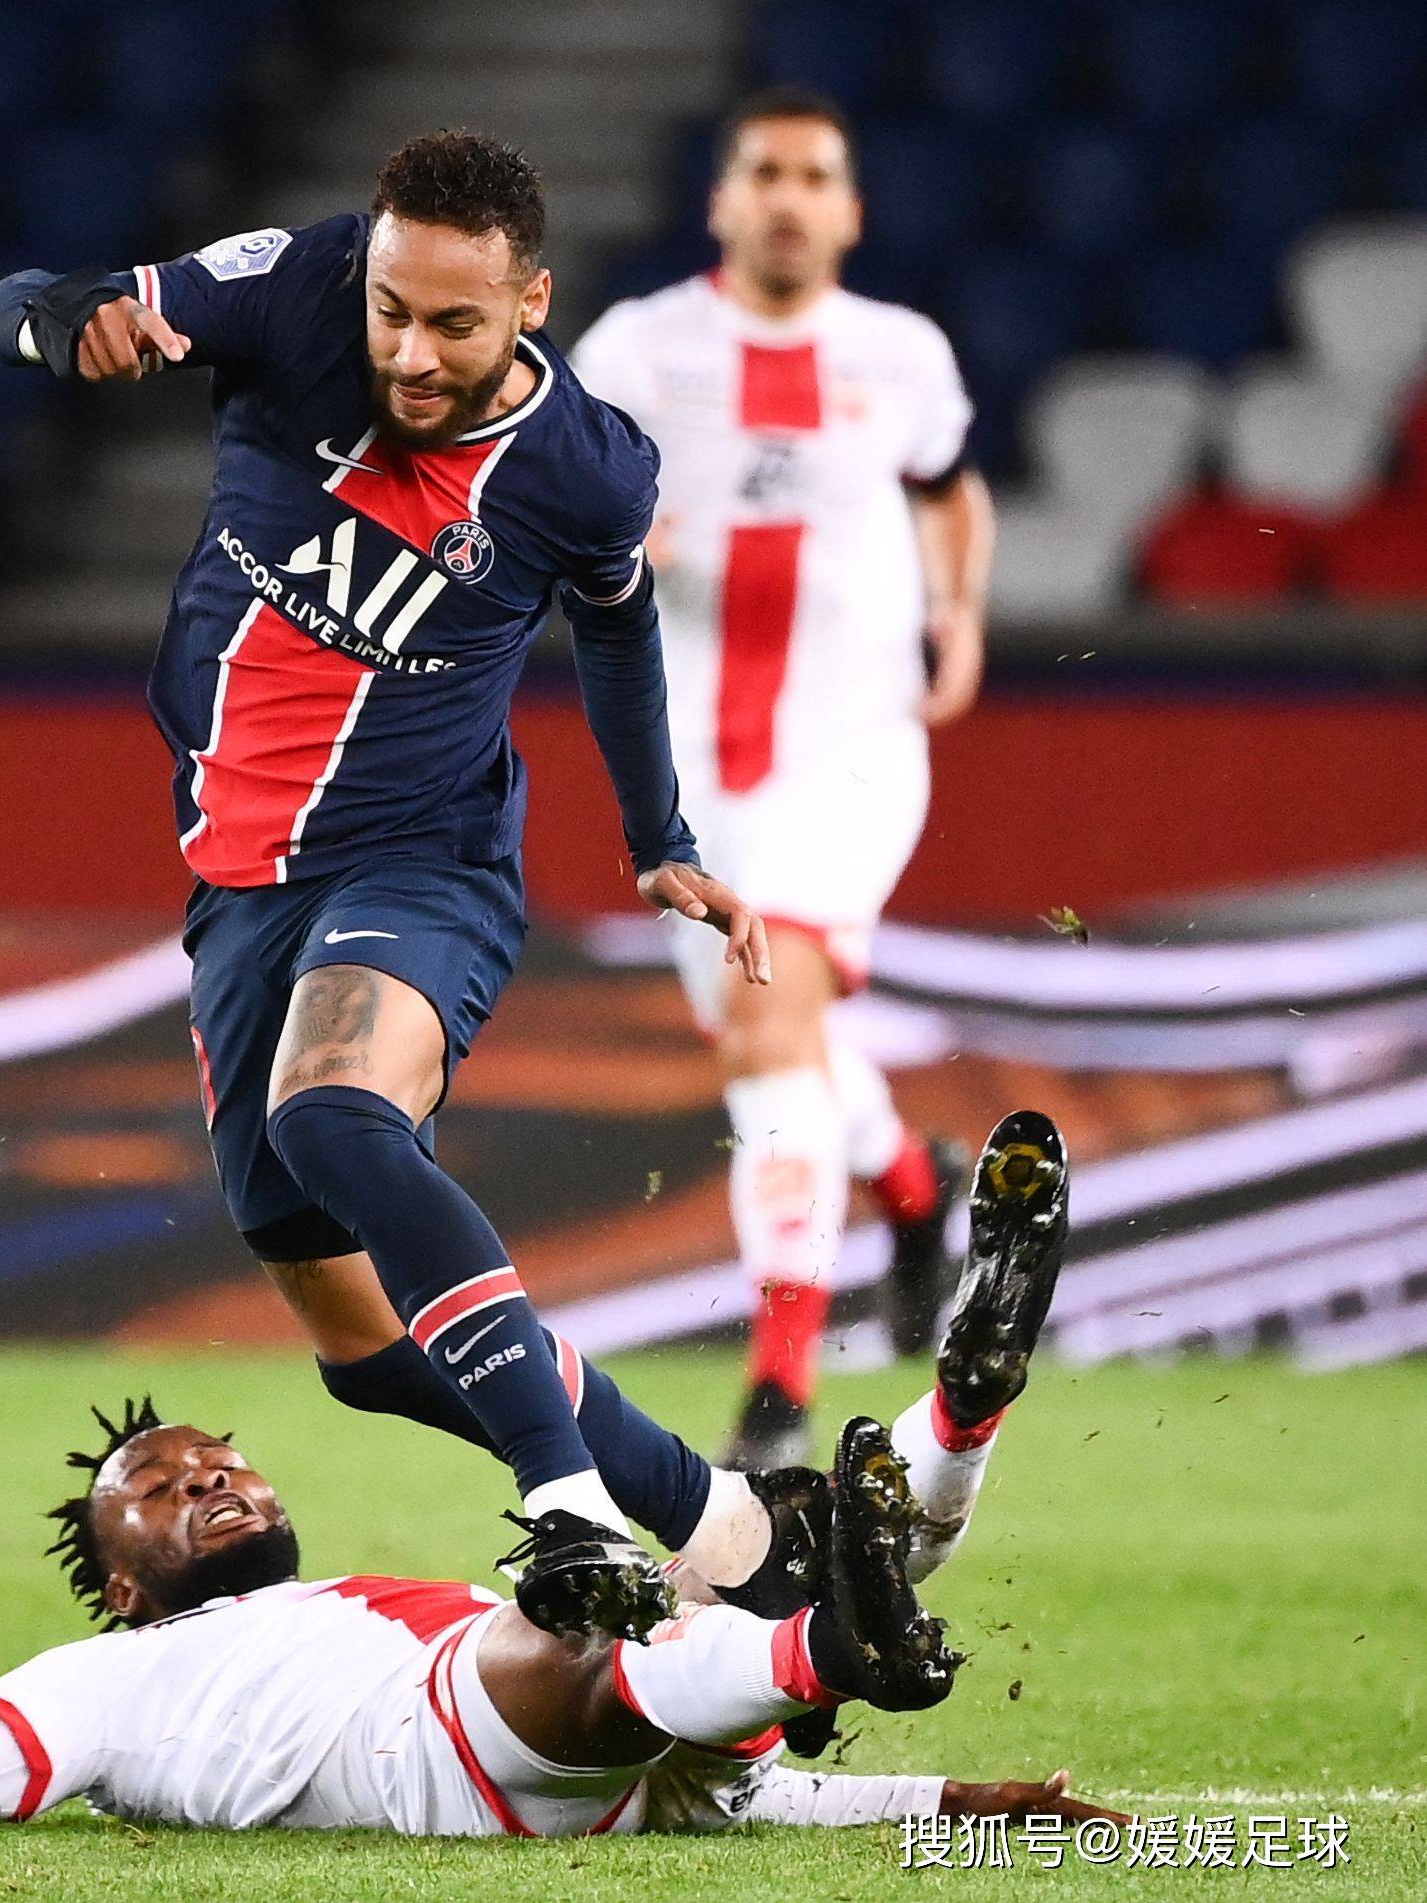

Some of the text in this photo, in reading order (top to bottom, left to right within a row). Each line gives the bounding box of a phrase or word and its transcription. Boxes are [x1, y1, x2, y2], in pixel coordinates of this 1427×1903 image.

[452, 525, 490, 549] PARIS
[216, 527, 283, 603] ACCOR
[284, 592, 340, 645] LIVE
[458, 1343, 527, 1391] PARIS
